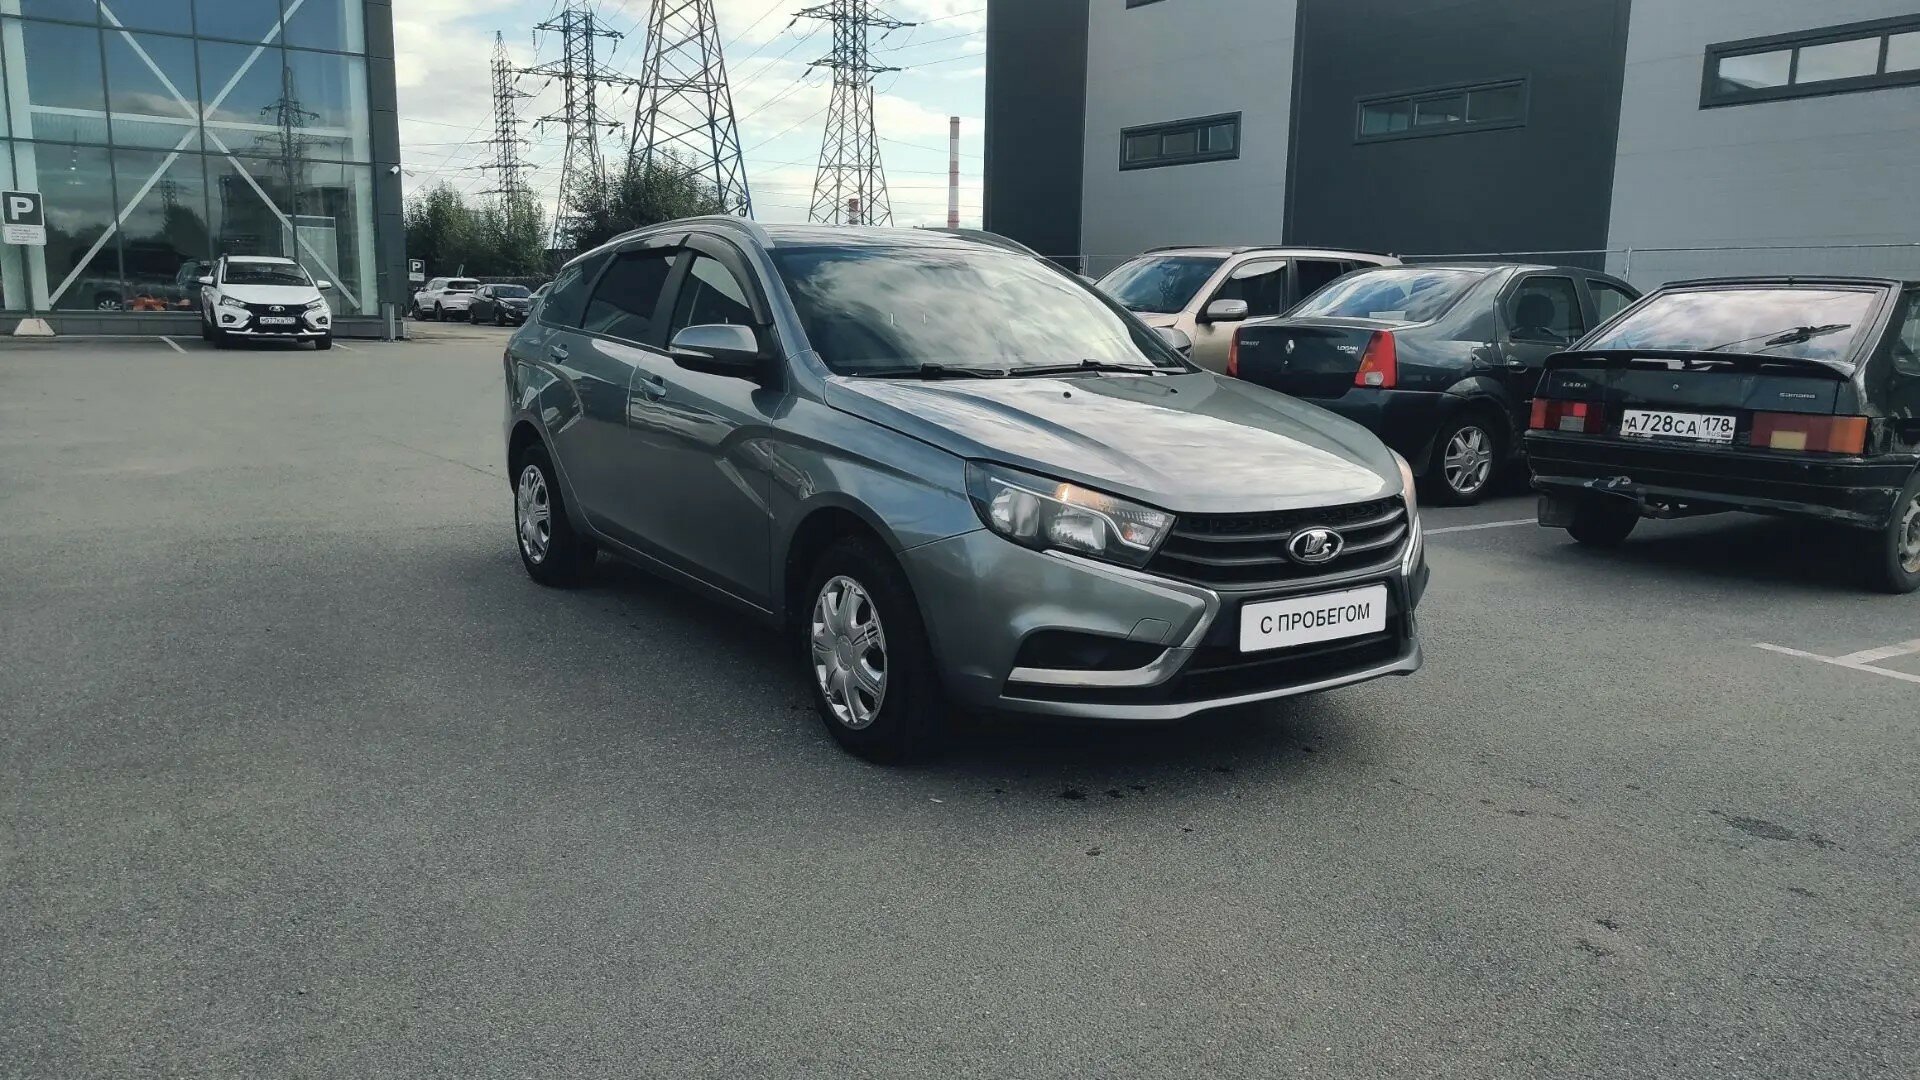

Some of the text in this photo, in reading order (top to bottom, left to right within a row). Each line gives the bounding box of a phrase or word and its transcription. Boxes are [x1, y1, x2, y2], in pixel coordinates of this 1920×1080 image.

[10, 196, 34, 220] P
[412, 261, 421, 271] P
[1627, 413, 1730, 435] А728СА 178
[1260, 602, 1371, 634] С ПРОБЕГОМ
